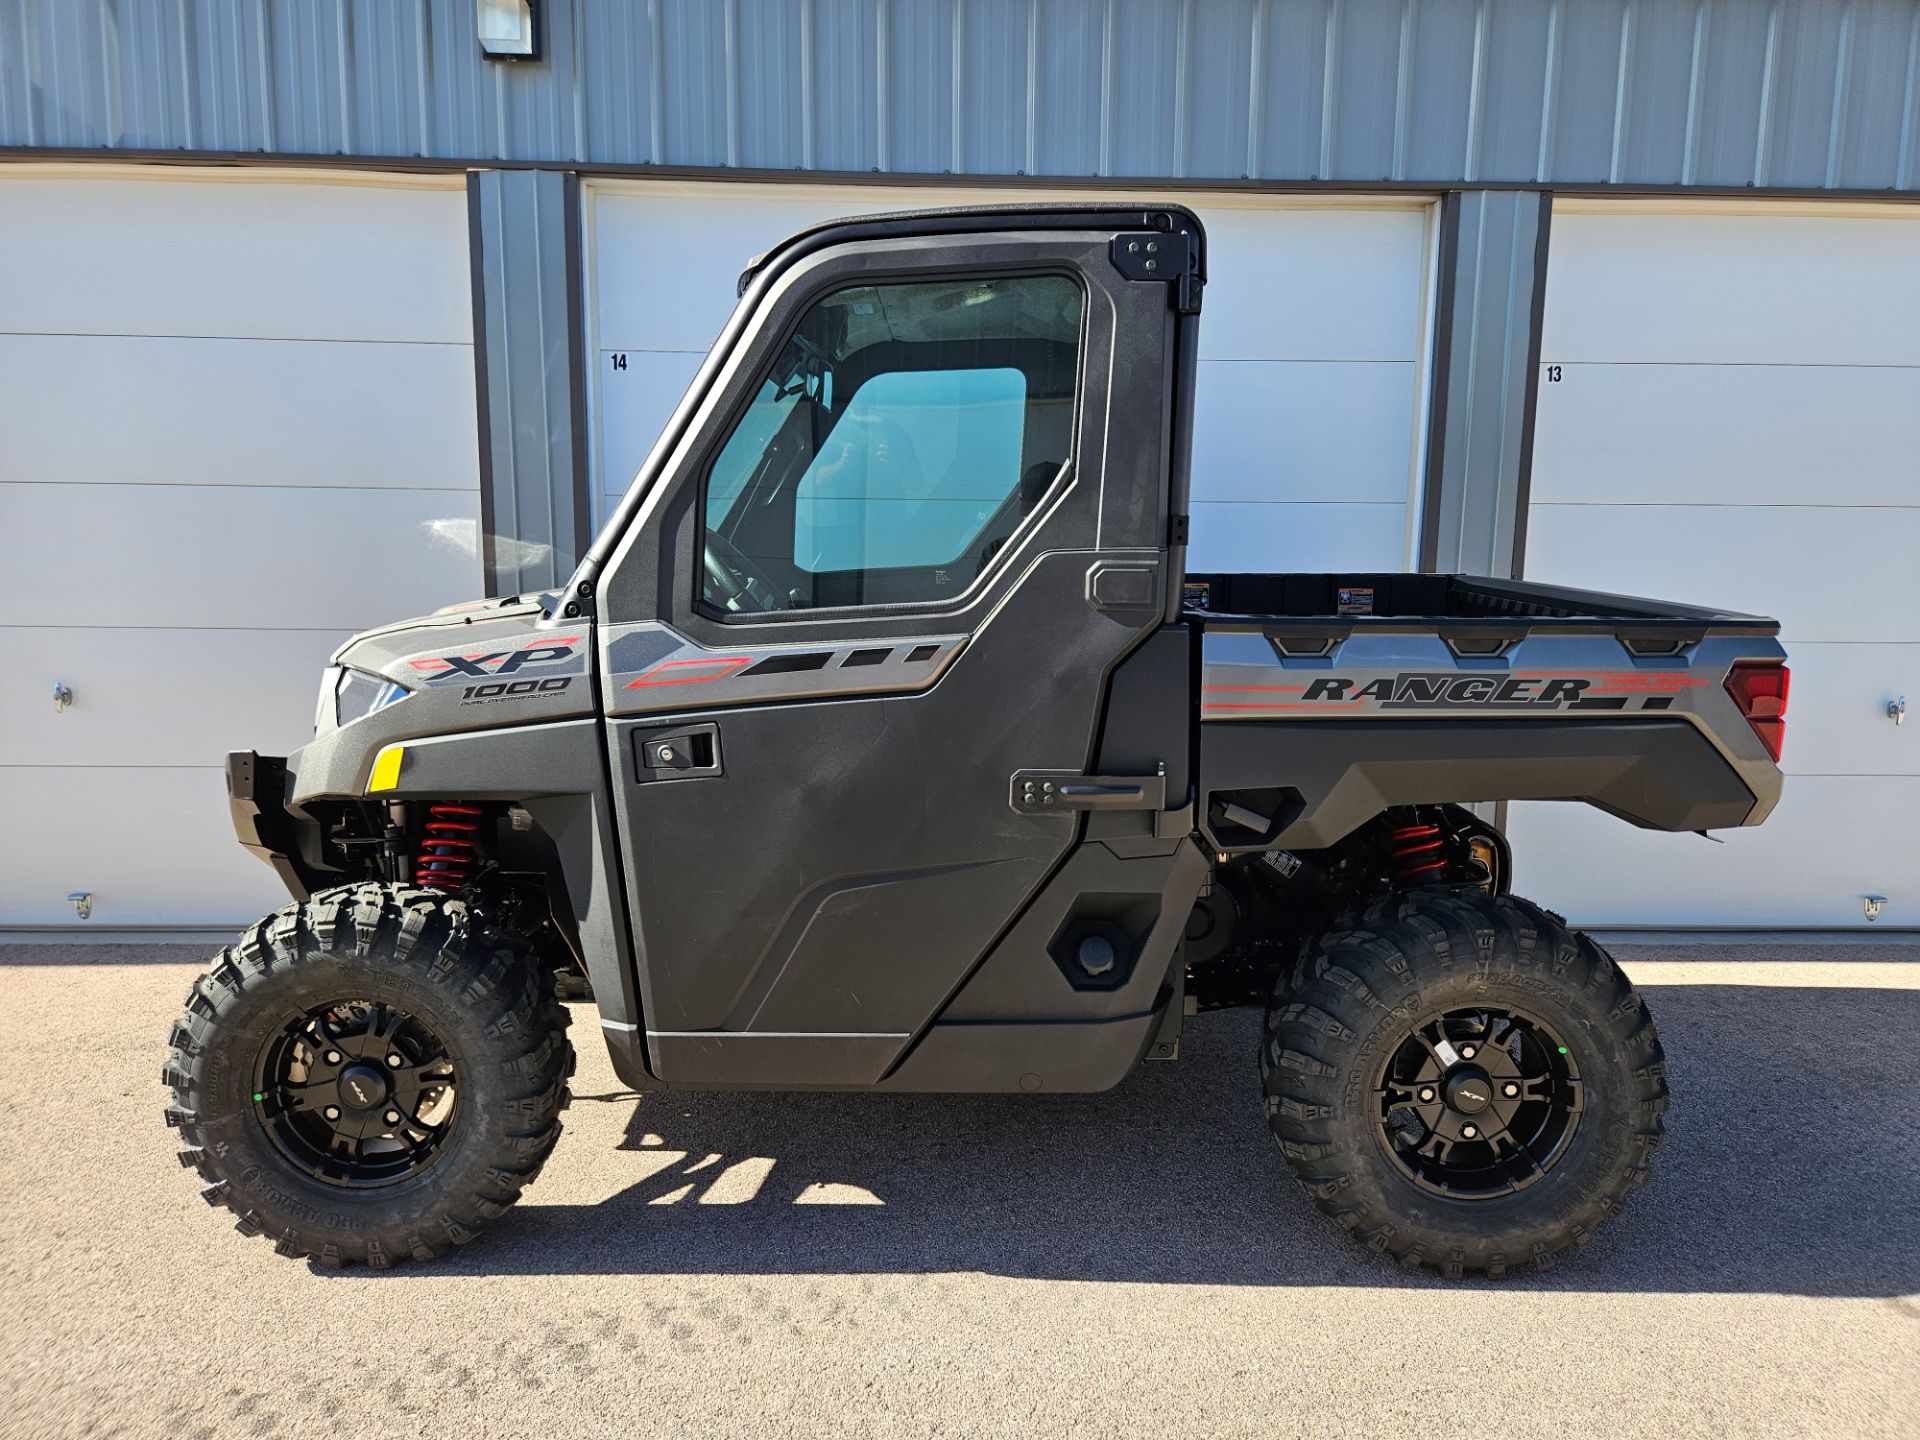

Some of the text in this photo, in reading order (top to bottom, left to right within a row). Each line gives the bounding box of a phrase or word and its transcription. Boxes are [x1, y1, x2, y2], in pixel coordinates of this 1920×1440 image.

[611, 353, 628, 371] 14
[1546, 365, 1562, 382] 13
[420, 645, 574, 682] XP
[462, 677, 572, 700] 1000
[1301, 677, 1591, 703] RANGER
[460, 699, 485, 707] DUAL
[487, 694, 541, 704] OVERHEAD
